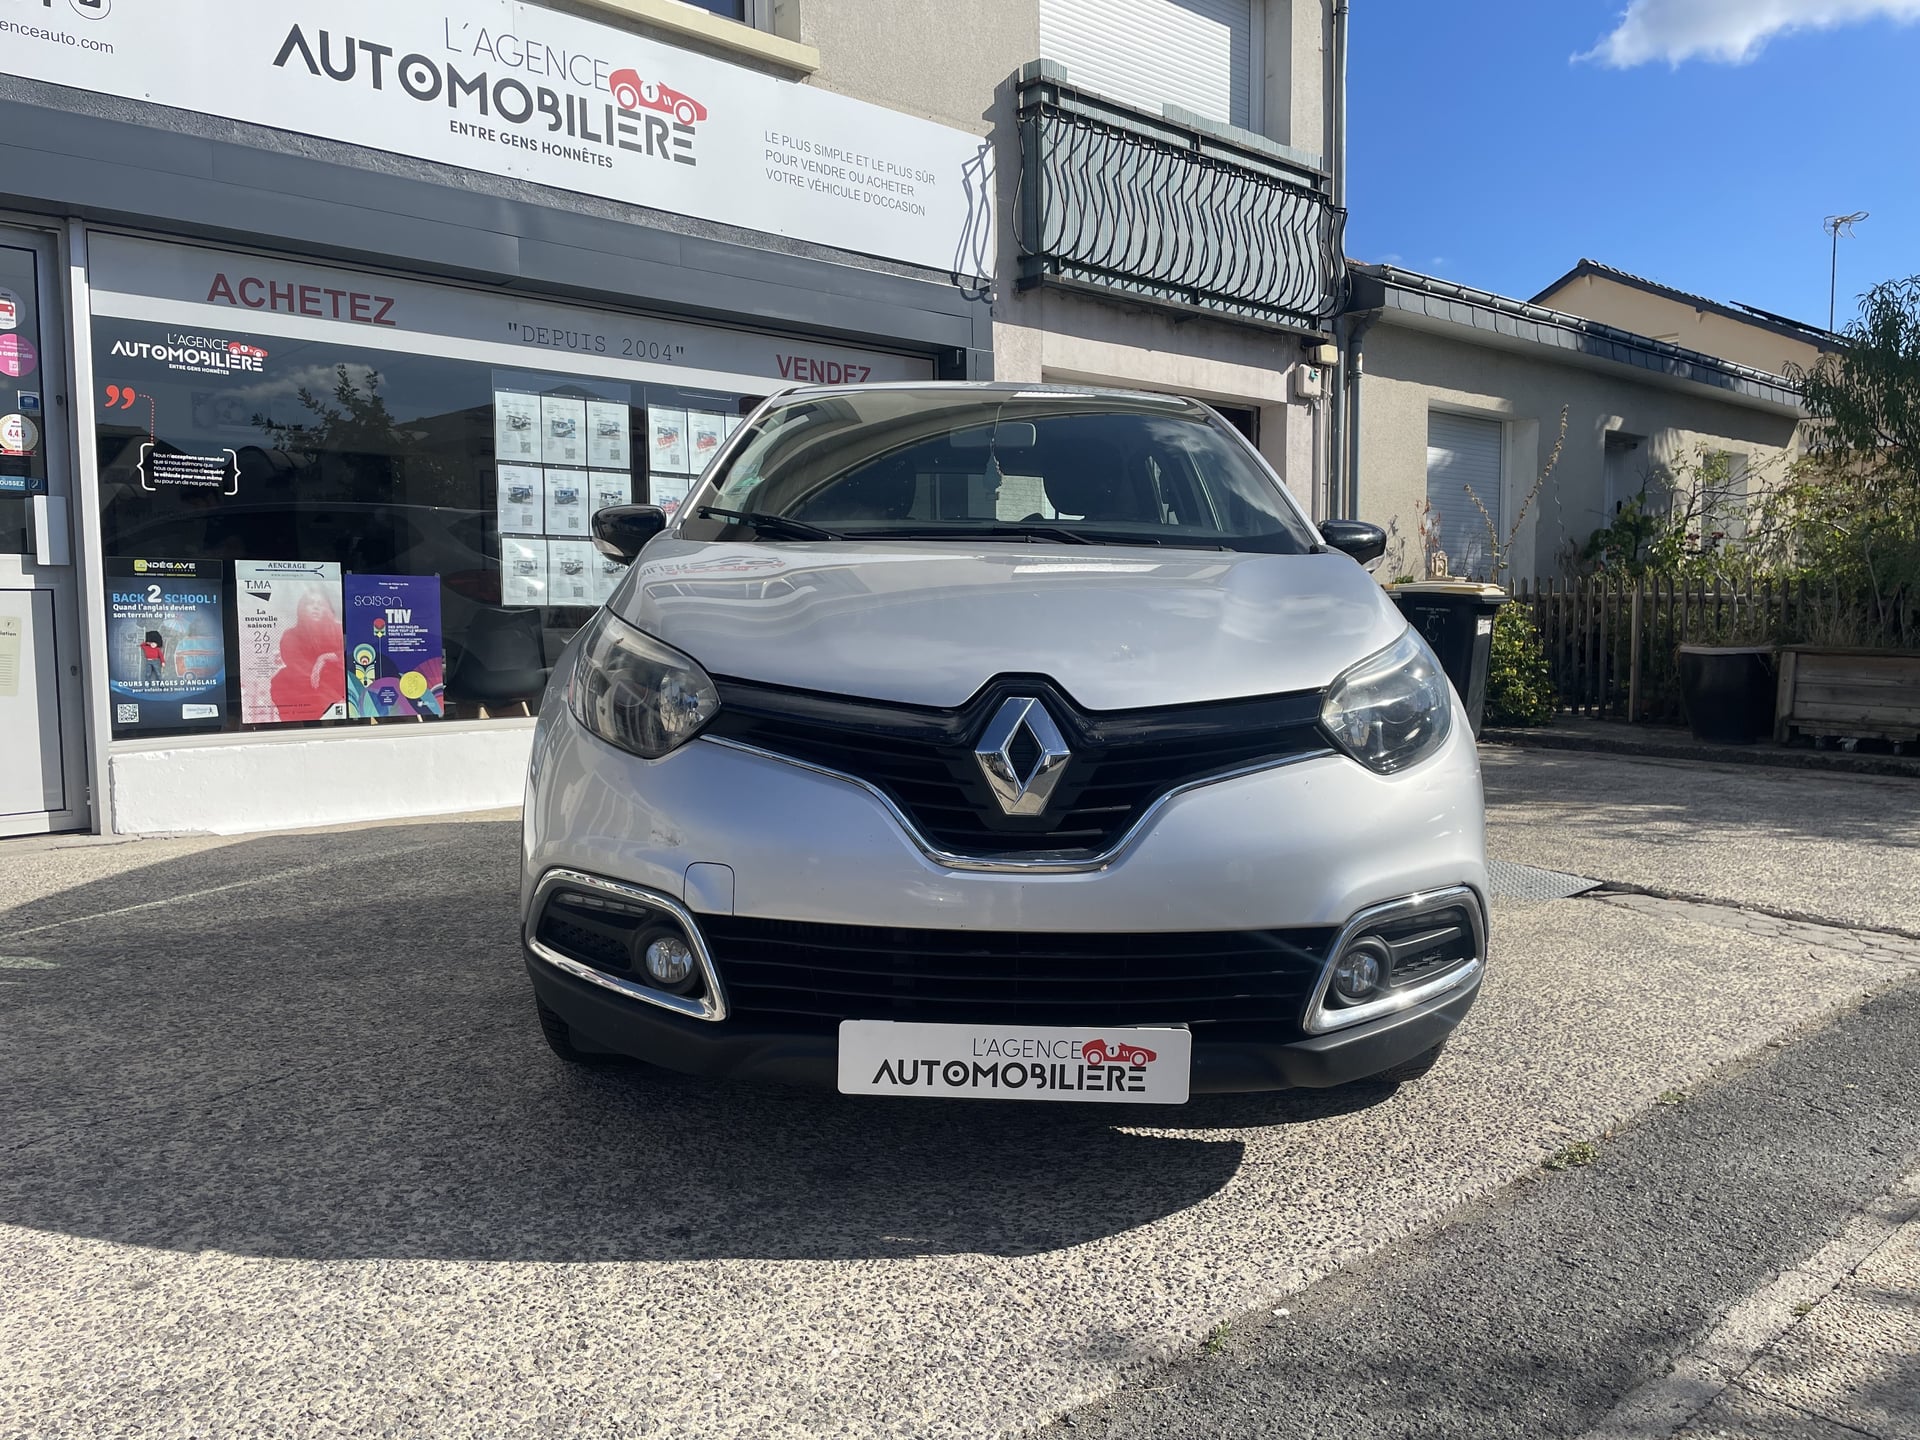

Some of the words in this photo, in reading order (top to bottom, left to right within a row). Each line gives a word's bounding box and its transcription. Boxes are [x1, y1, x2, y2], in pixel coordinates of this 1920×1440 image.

[0, 20, 114, 54] enceauto.com
[444, 17, 610, 92] L'AGENCE
[450, 120, 496, 142] ENTRE
[500, 132, 538, 151] GENS
[541, 141, 613, 168] HONNÊTES
[765, 130, 779, 144] LE
[782, 135, 811, 153] PLUS
[814, 144, 853, 164] SIMPLE
[856, 154, 869, 167] ET
[871, 158, 884, 172] LE
[887, 163, 913, 179] PLUS
[915, 169, 936, 185] SÛR
[765, 149, 798, 168] POUR
[800, 158, 846, 179] VENDRE
[849, 170, 864, 184] OU
[867, 176, 914, 196] ACHETER
[765, 167, 804, 188] VOTRE
[807, 177, 861, 201] VÉHICULE
[864, 191, 926, 217] D'OCCASION
[206, 273, 396, 326] ACHETEZ
[167, 333, 228, 351] L'AGENCE
[507, 322, 606, 353] "DEPUIS
[622, 338, 684, 361] 2004"
[202, 367, 230, 375] HONNÊTES
[112, 593, 145, 602] BACK
[147, 584, 162, 603] 2
[164, 594, 210, 604] SCHOOL
[138, 604, 169, 612] l'anglais
[254, 631, 270, 642] 26
[254, 643, 271, 654] 27
[972, 1037, 1083, 1060] L'AGENCE
